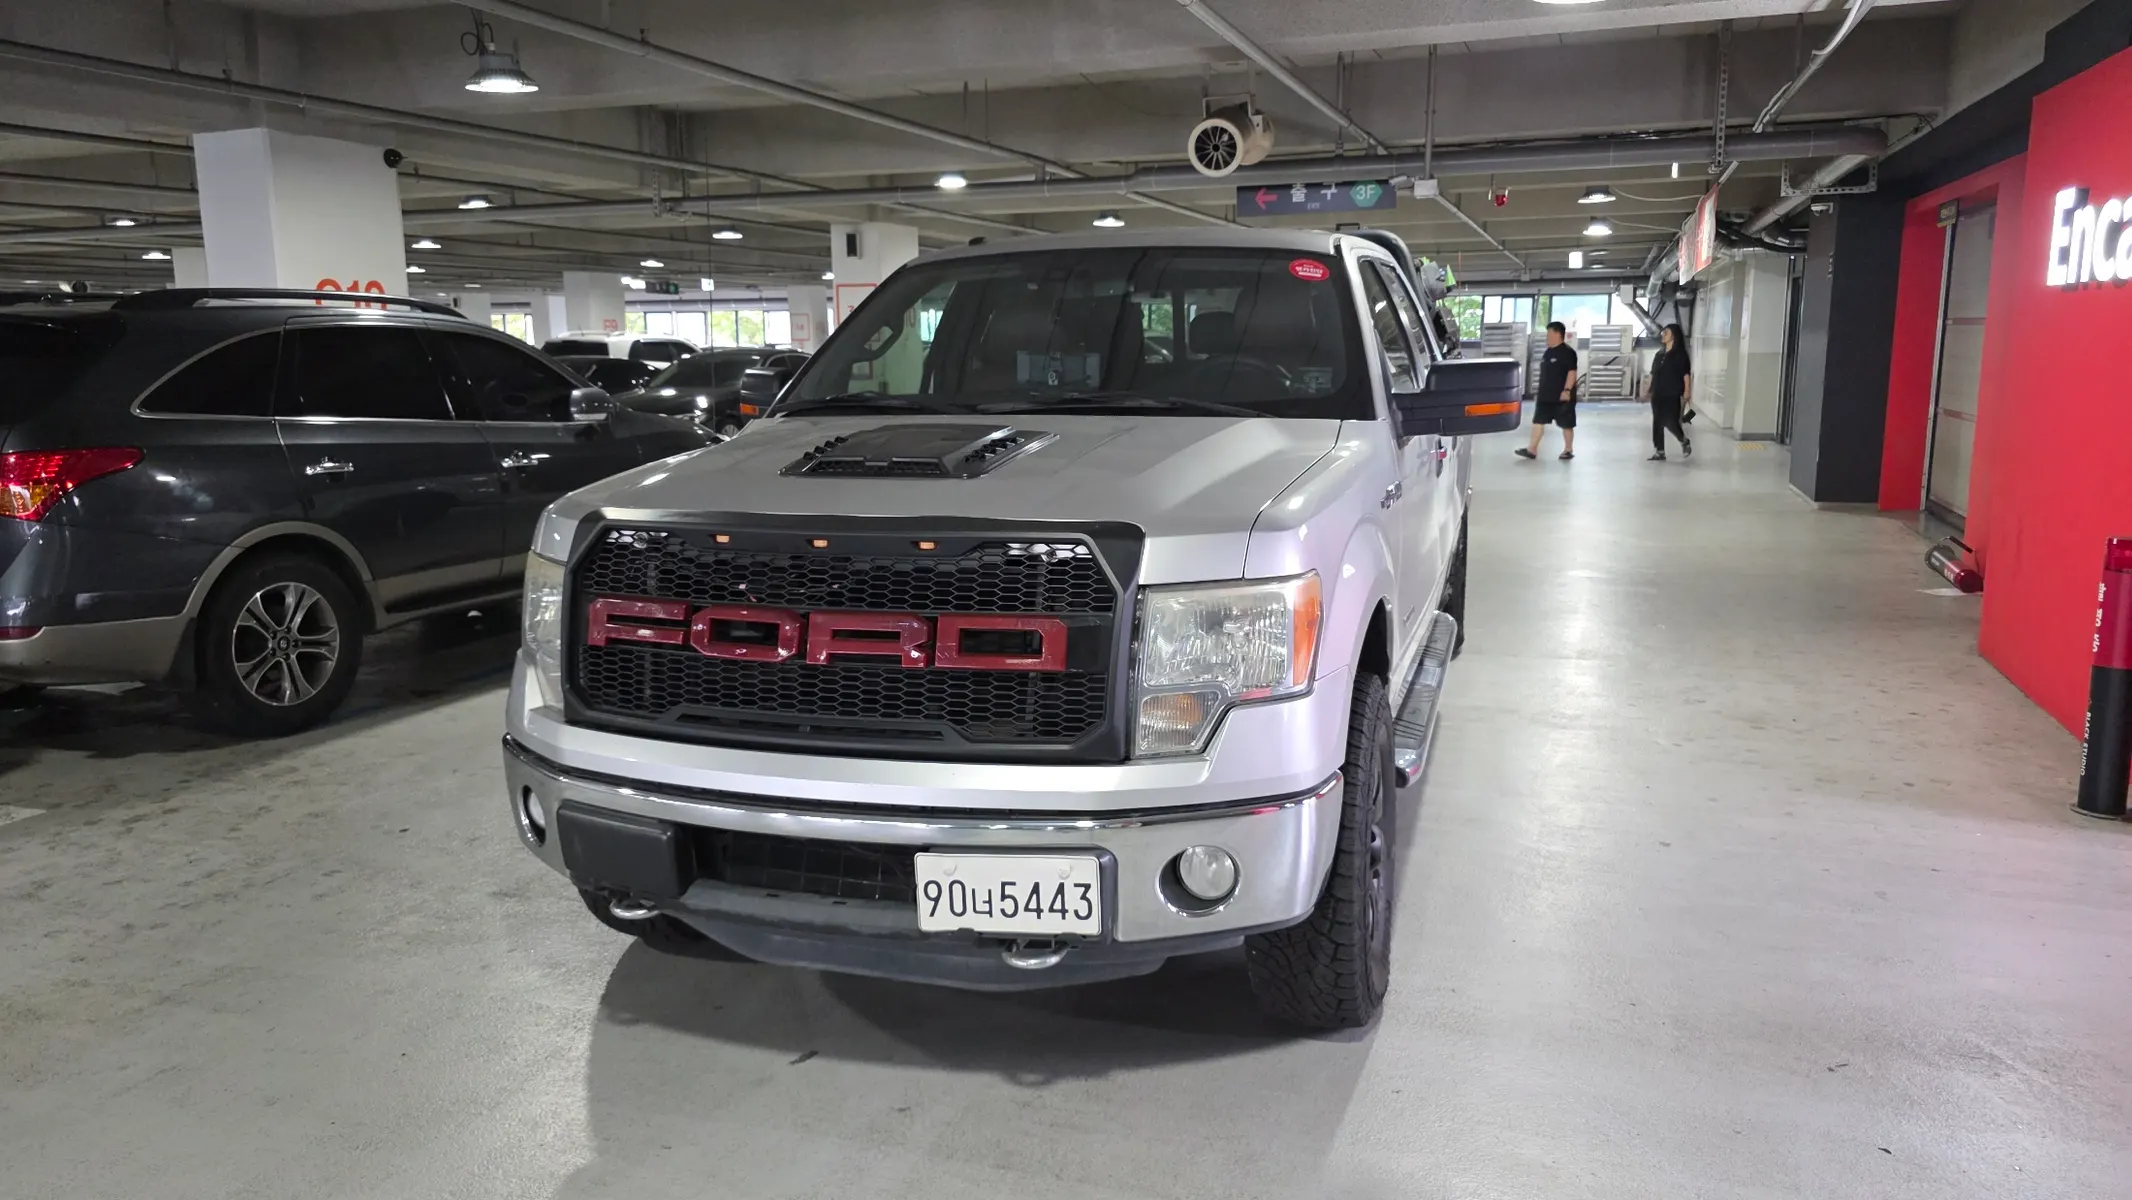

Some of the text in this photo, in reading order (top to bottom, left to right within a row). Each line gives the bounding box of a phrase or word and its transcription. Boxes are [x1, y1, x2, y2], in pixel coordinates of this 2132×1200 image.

[1356, 184, 1376, 200] 3F
[588, 598, 1067, 671] FORD
[2080, 711, 2092, 776] BLACK STUDIO
[923, 879, 1093, 921] 90너5443
